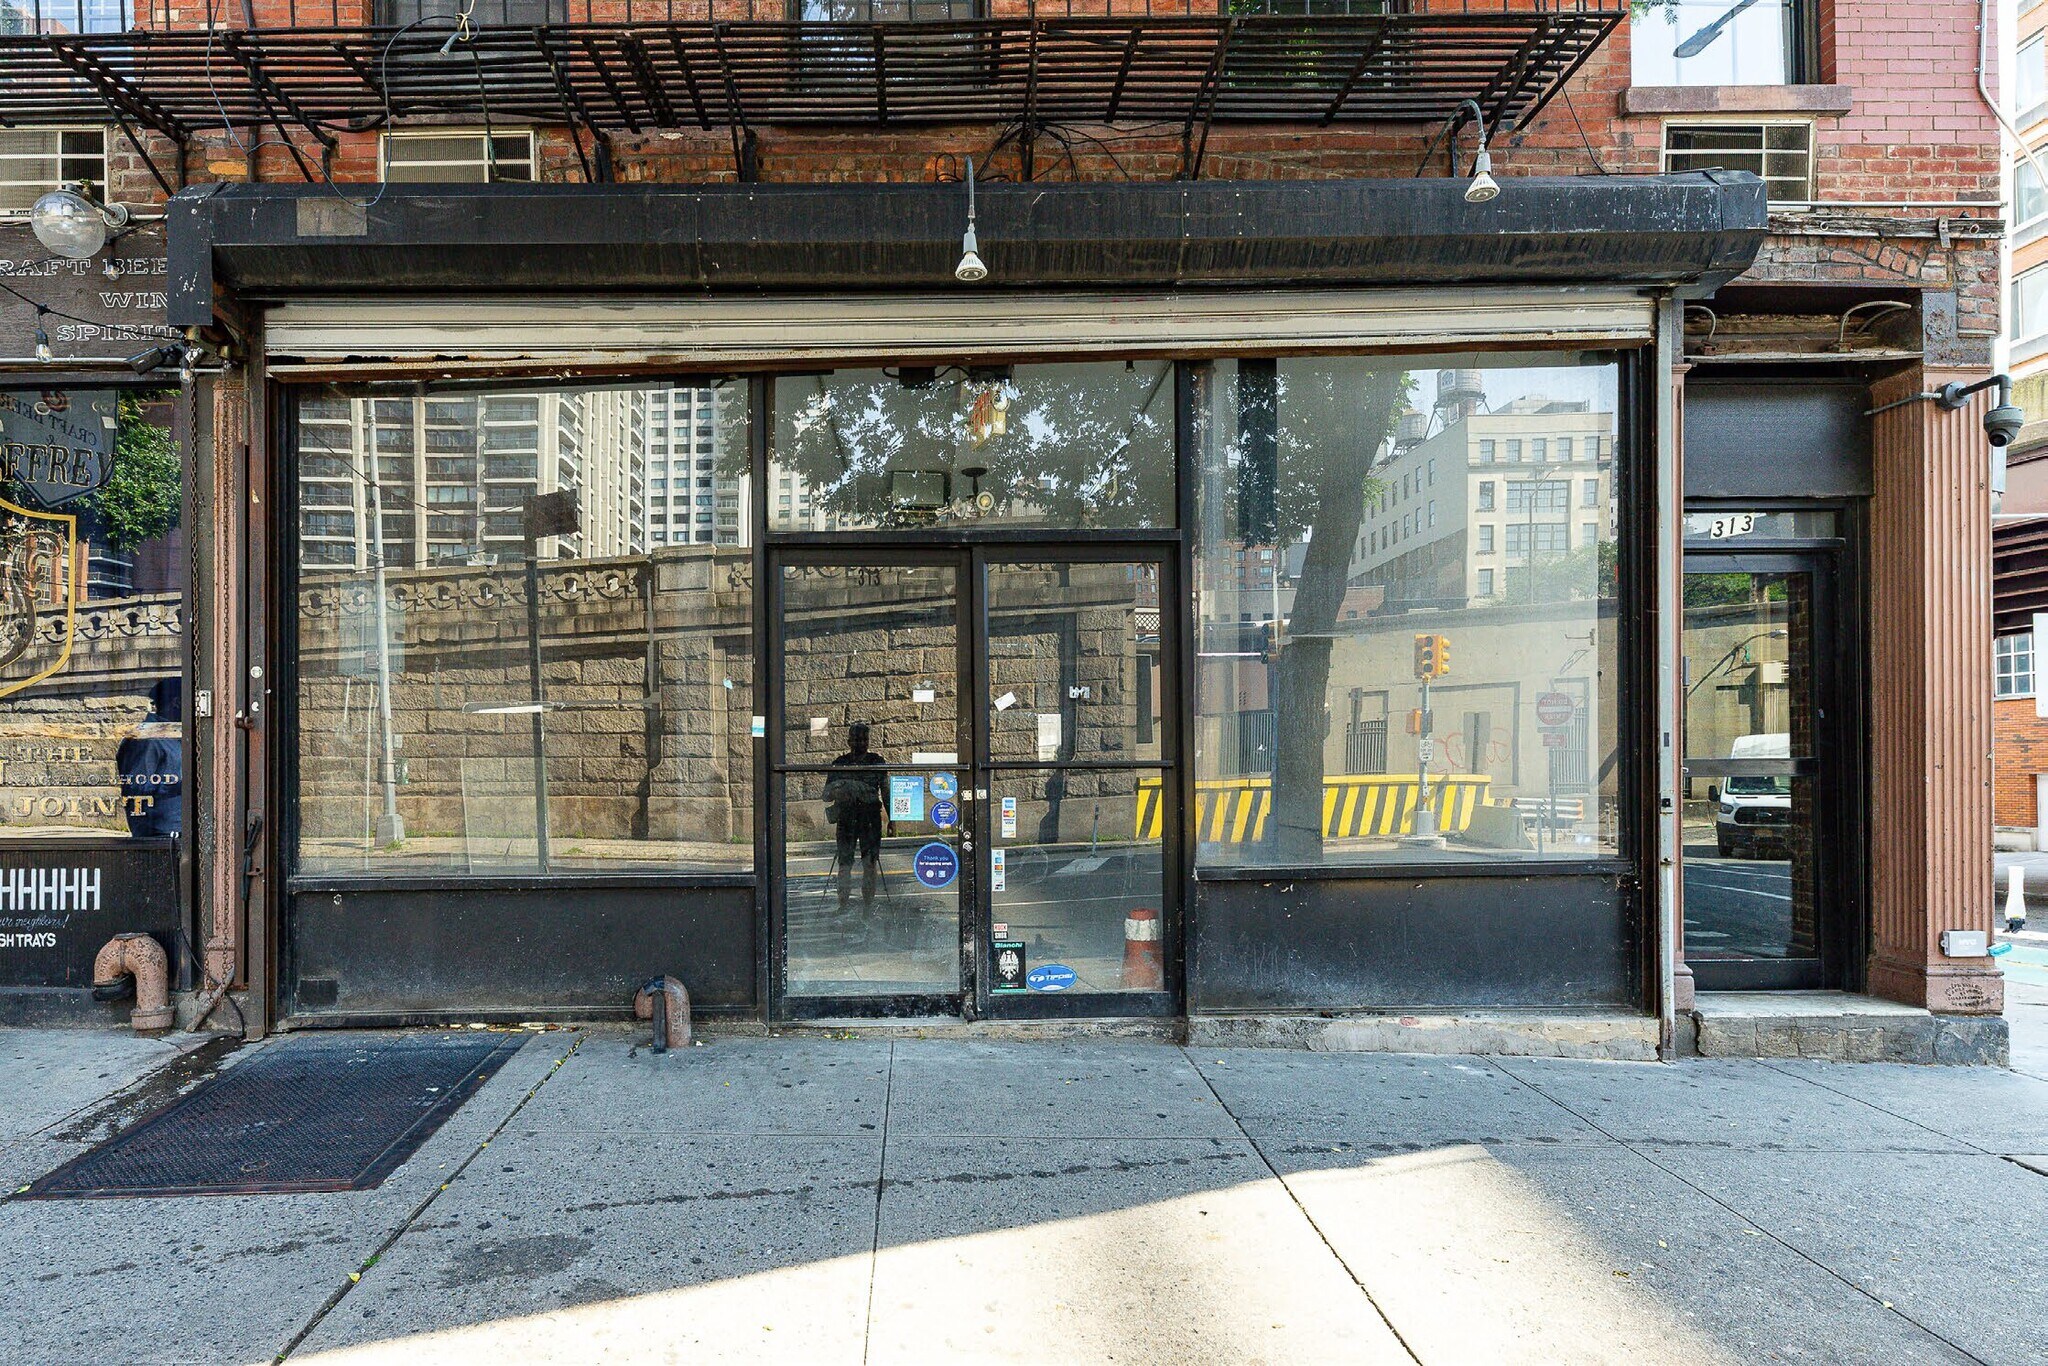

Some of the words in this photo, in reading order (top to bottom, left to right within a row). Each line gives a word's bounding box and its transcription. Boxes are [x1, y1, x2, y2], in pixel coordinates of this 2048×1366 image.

[0, 443, 118, 488] FFREY
[1712, 515, 1752, 538] 313
[858, 568, 881, 586] 313
[17, 746, 92, 763] THE
[11, 795, 154, 817] JOINT
